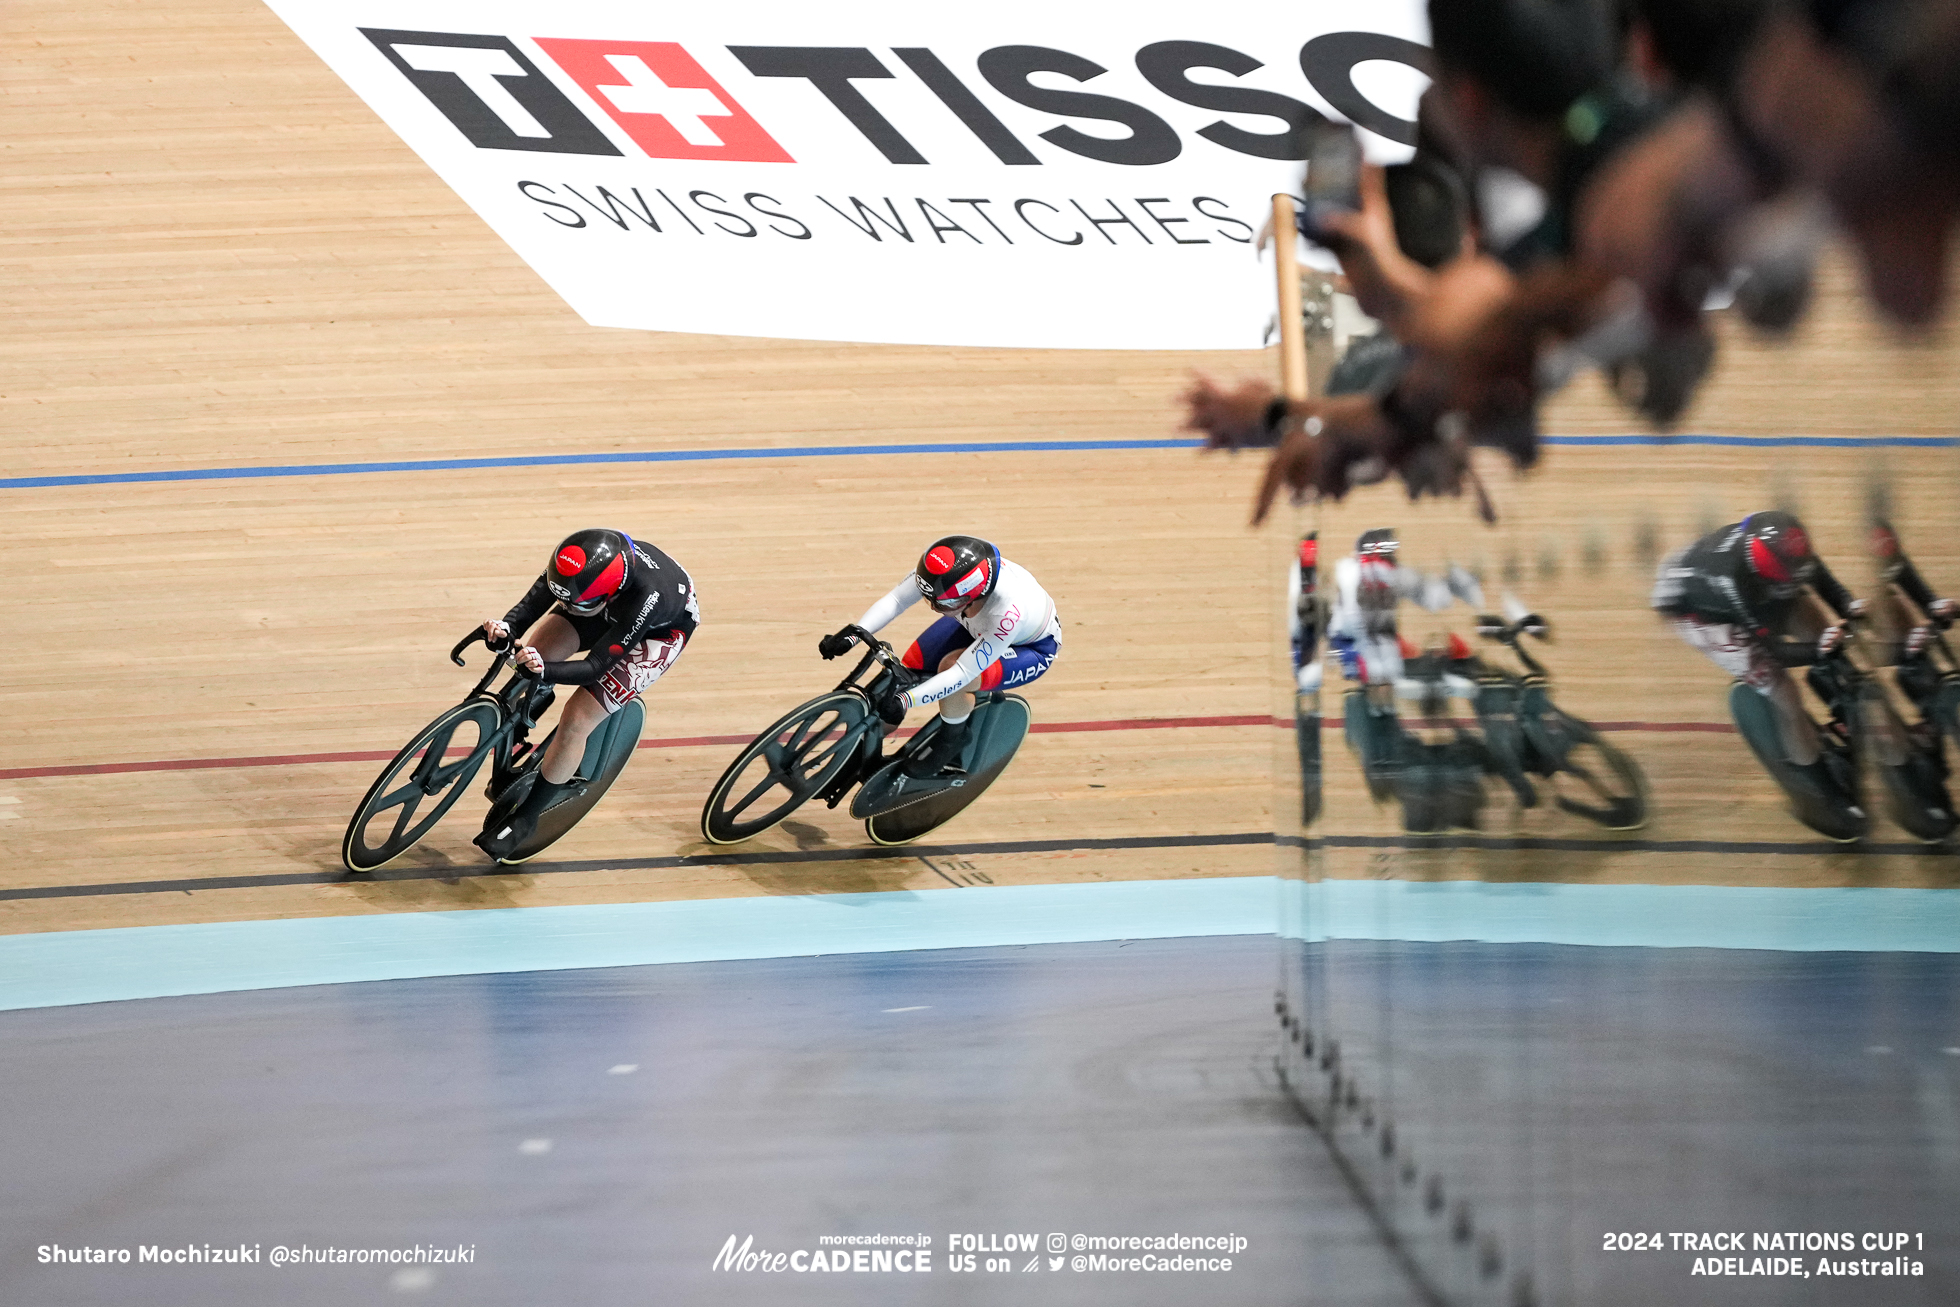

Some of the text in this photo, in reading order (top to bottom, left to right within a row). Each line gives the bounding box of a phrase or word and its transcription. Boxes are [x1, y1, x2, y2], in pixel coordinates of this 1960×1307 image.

[516, 180, 813, 240] SWISS
[816, 195, 1254, 246] WATCHES
[559, 554, 582, 569] JAPAN
[929, 552, 949, 569] JAPAN
[1003, 653, 1057, 685] JAPAN
[921, 679, 963, 704] Cyclers
